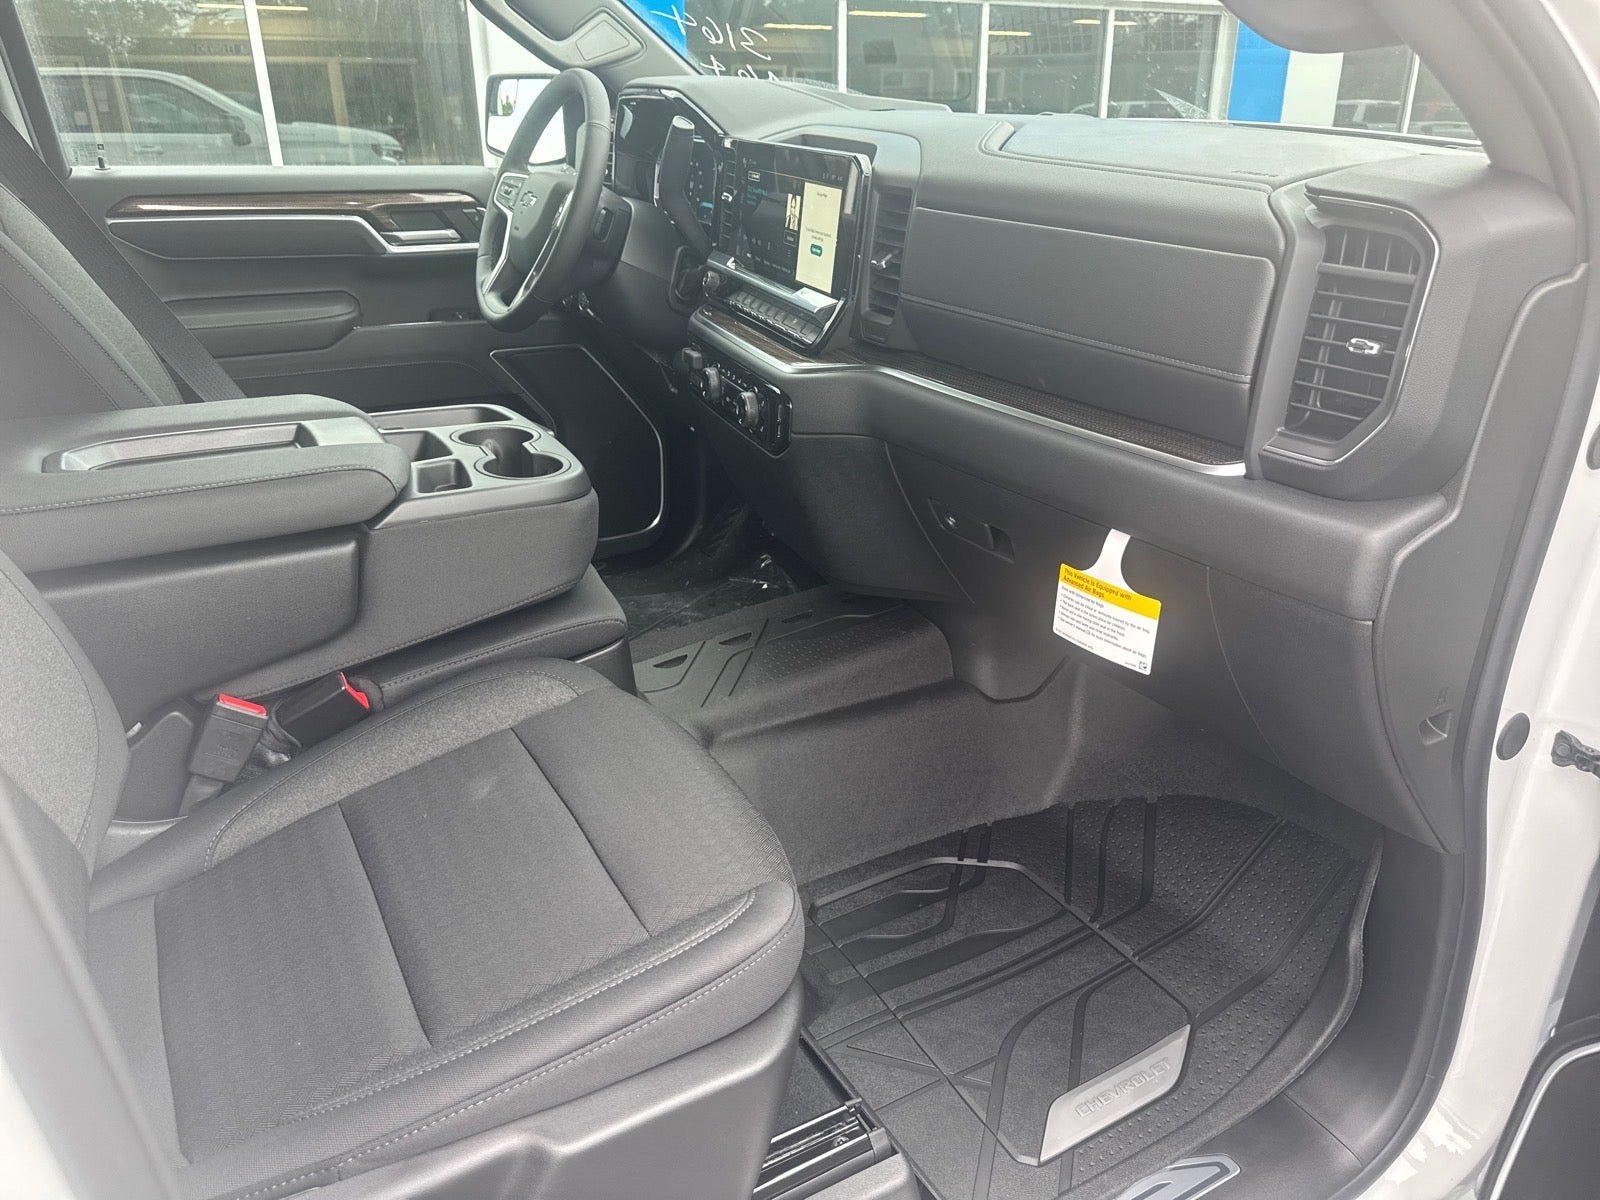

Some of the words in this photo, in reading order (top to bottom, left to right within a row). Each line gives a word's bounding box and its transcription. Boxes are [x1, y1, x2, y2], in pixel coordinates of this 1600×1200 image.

[1063, 575, 1084, 590] Advanced
[1092, 588, 1104, 598] Bags
[1064, 568, 1073, 577] This
[1074, 573, 1090, 585] Vehicle
[1096, 582, 1119, 597] Equipped
[1120, 591, 1132, 601] with
[1074, 1056, 1172, 1118] CHEVROLET
